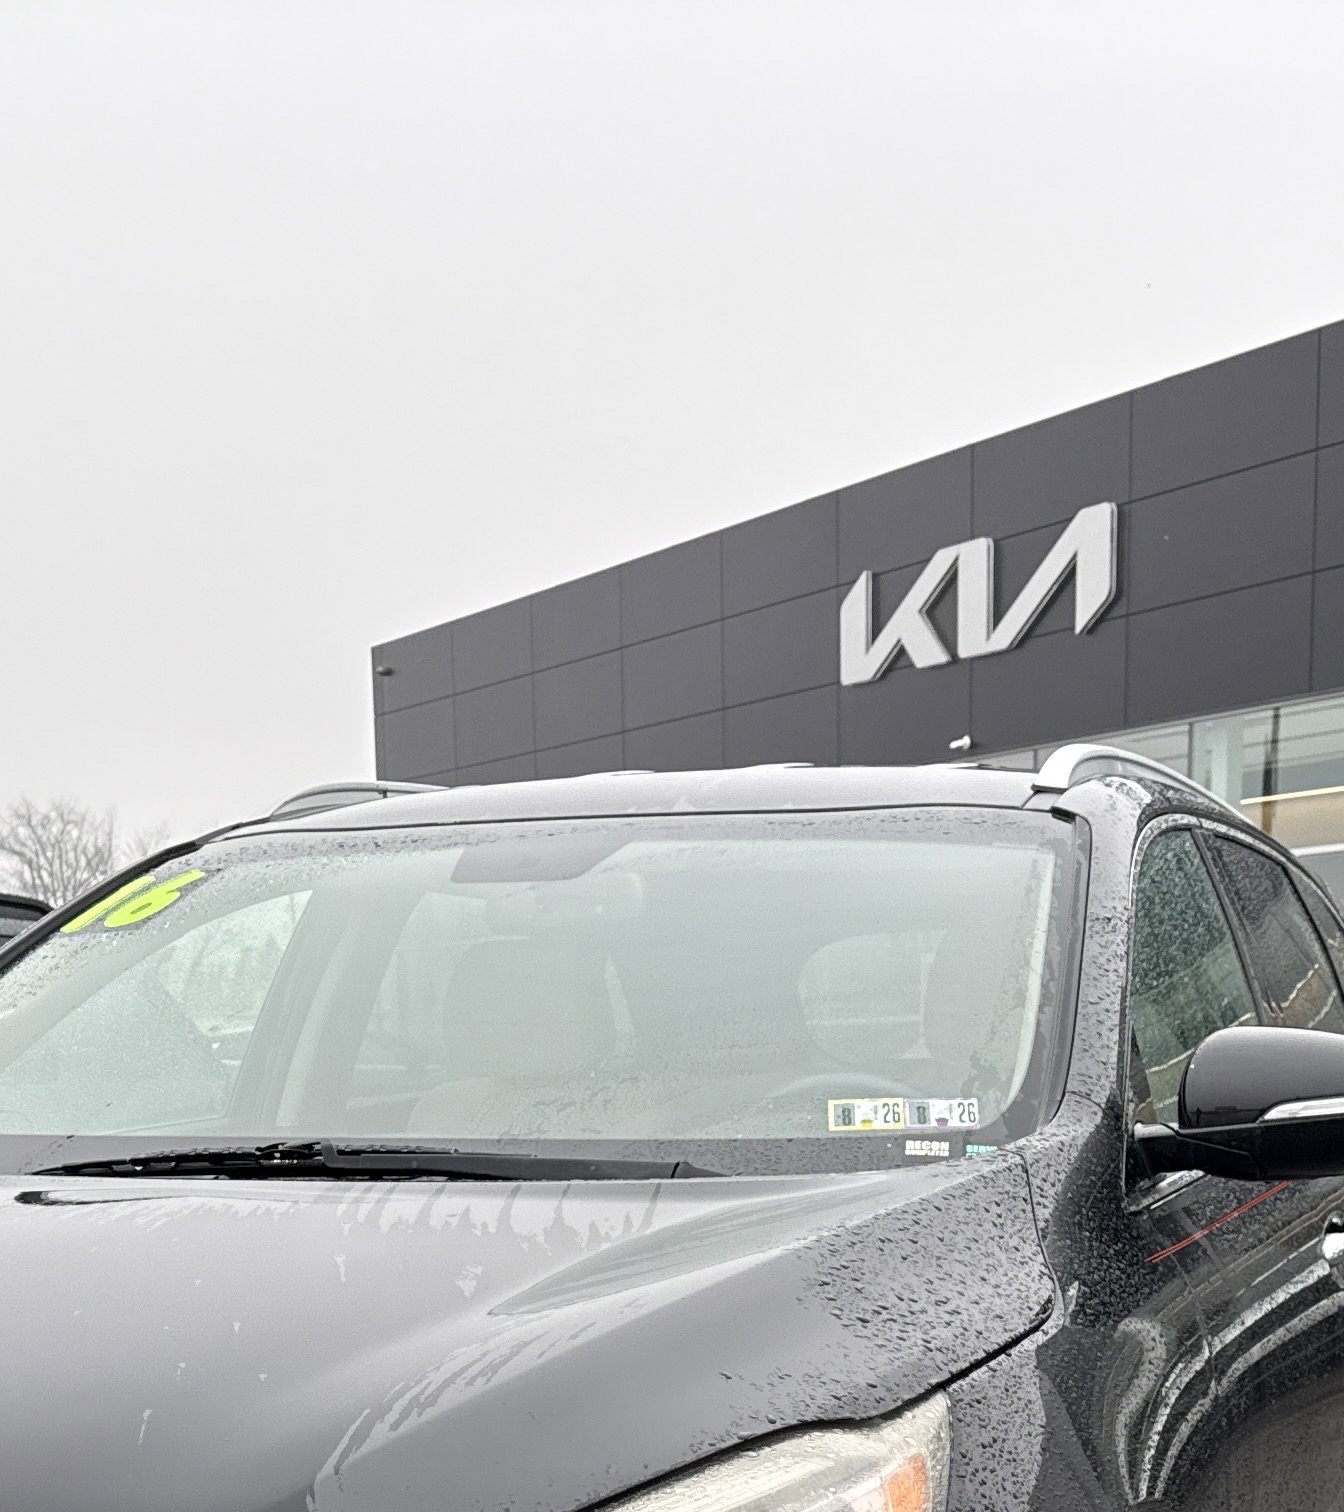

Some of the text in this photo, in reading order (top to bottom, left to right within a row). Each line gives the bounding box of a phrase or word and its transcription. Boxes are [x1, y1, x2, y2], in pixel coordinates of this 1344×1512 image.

[840, 502, 1118, 687] KIA
[59, 869, 206, 933] 16
[882, 1103, 901, 1124] 26
[958, 1102, 977, 1123] 26
[905, 1140, 950, 1151] RECON
